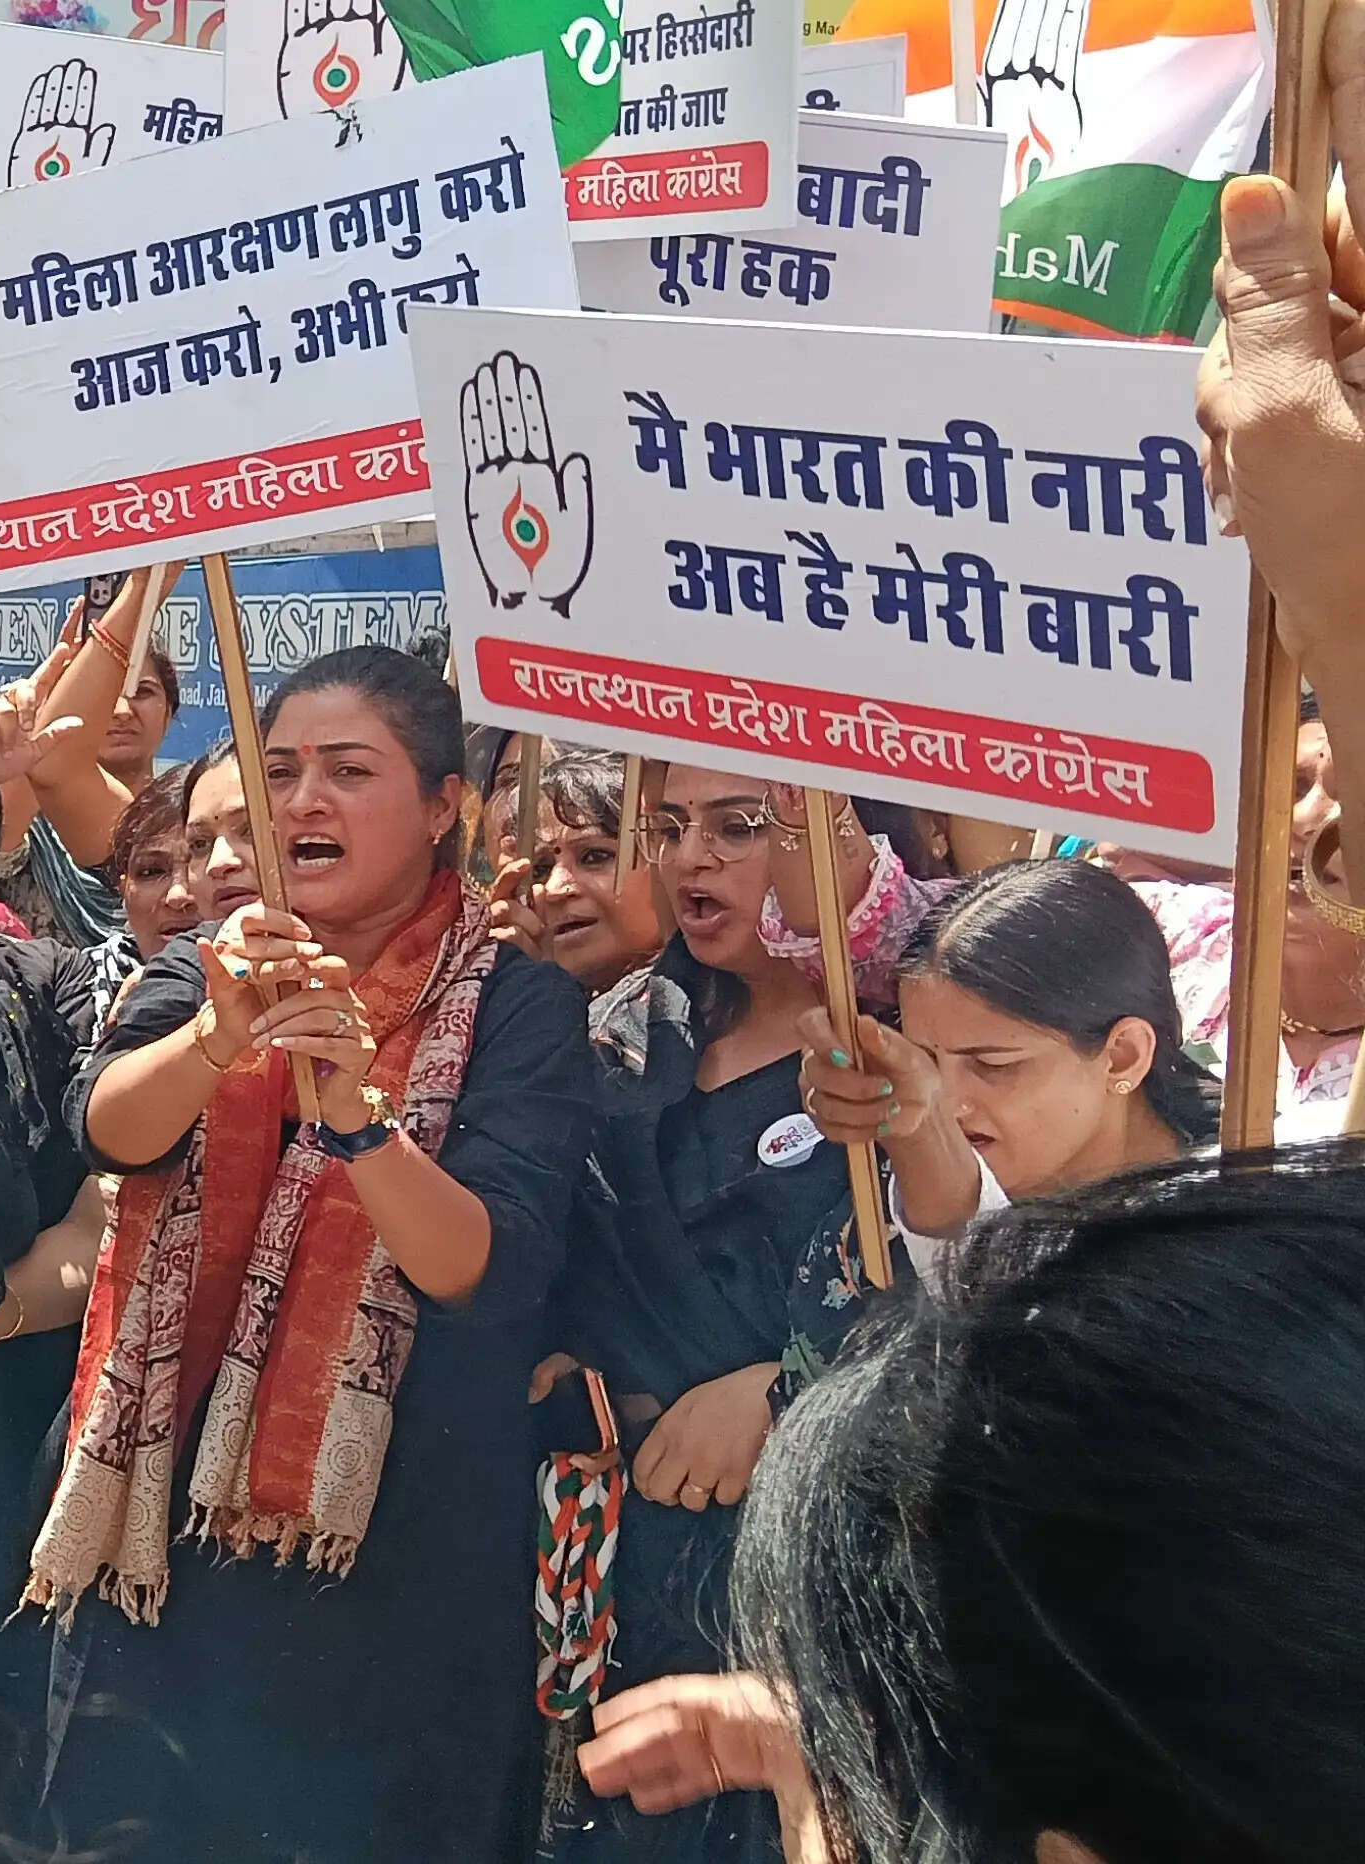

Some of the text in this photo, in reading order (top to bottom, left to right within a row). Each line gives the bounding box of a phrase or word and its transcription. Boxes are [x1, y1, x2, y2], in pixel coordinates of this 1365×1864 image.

[622, 22, 650, 66] पर
[656, 3, 756, 58] हिस्सेदारी
[143, 98, 224, 145] महिल
[647, 84, 677, 133] की
[681, 86, 729, 129] जाए
[577, 160, 661, 211] महिला
[666, 151, 742, 200] कांग्रेस
[798, 155, 932, 237] बादी
[0, 137, 528, 327] महिला आरक्षण लागु करो
[650, 235, 837, 307] पूरा हक
[69, 336, 172, 415] आज
[182, 305, 283, 386] करो,
[291, 282, 394, 367] अभी
[89, 484, 198, 542] प्रदेश
[205, 456, 343, 518] महिला
[622, 390, 1209, 547] मै भारत की नारी
[665, 530, 1200, 684] अब है मेरी बारी
[179, 681, 204, 708] oad,
[509, 654, 1150, 811] राजस्थान प्रदेश महिला कांग्रेस
